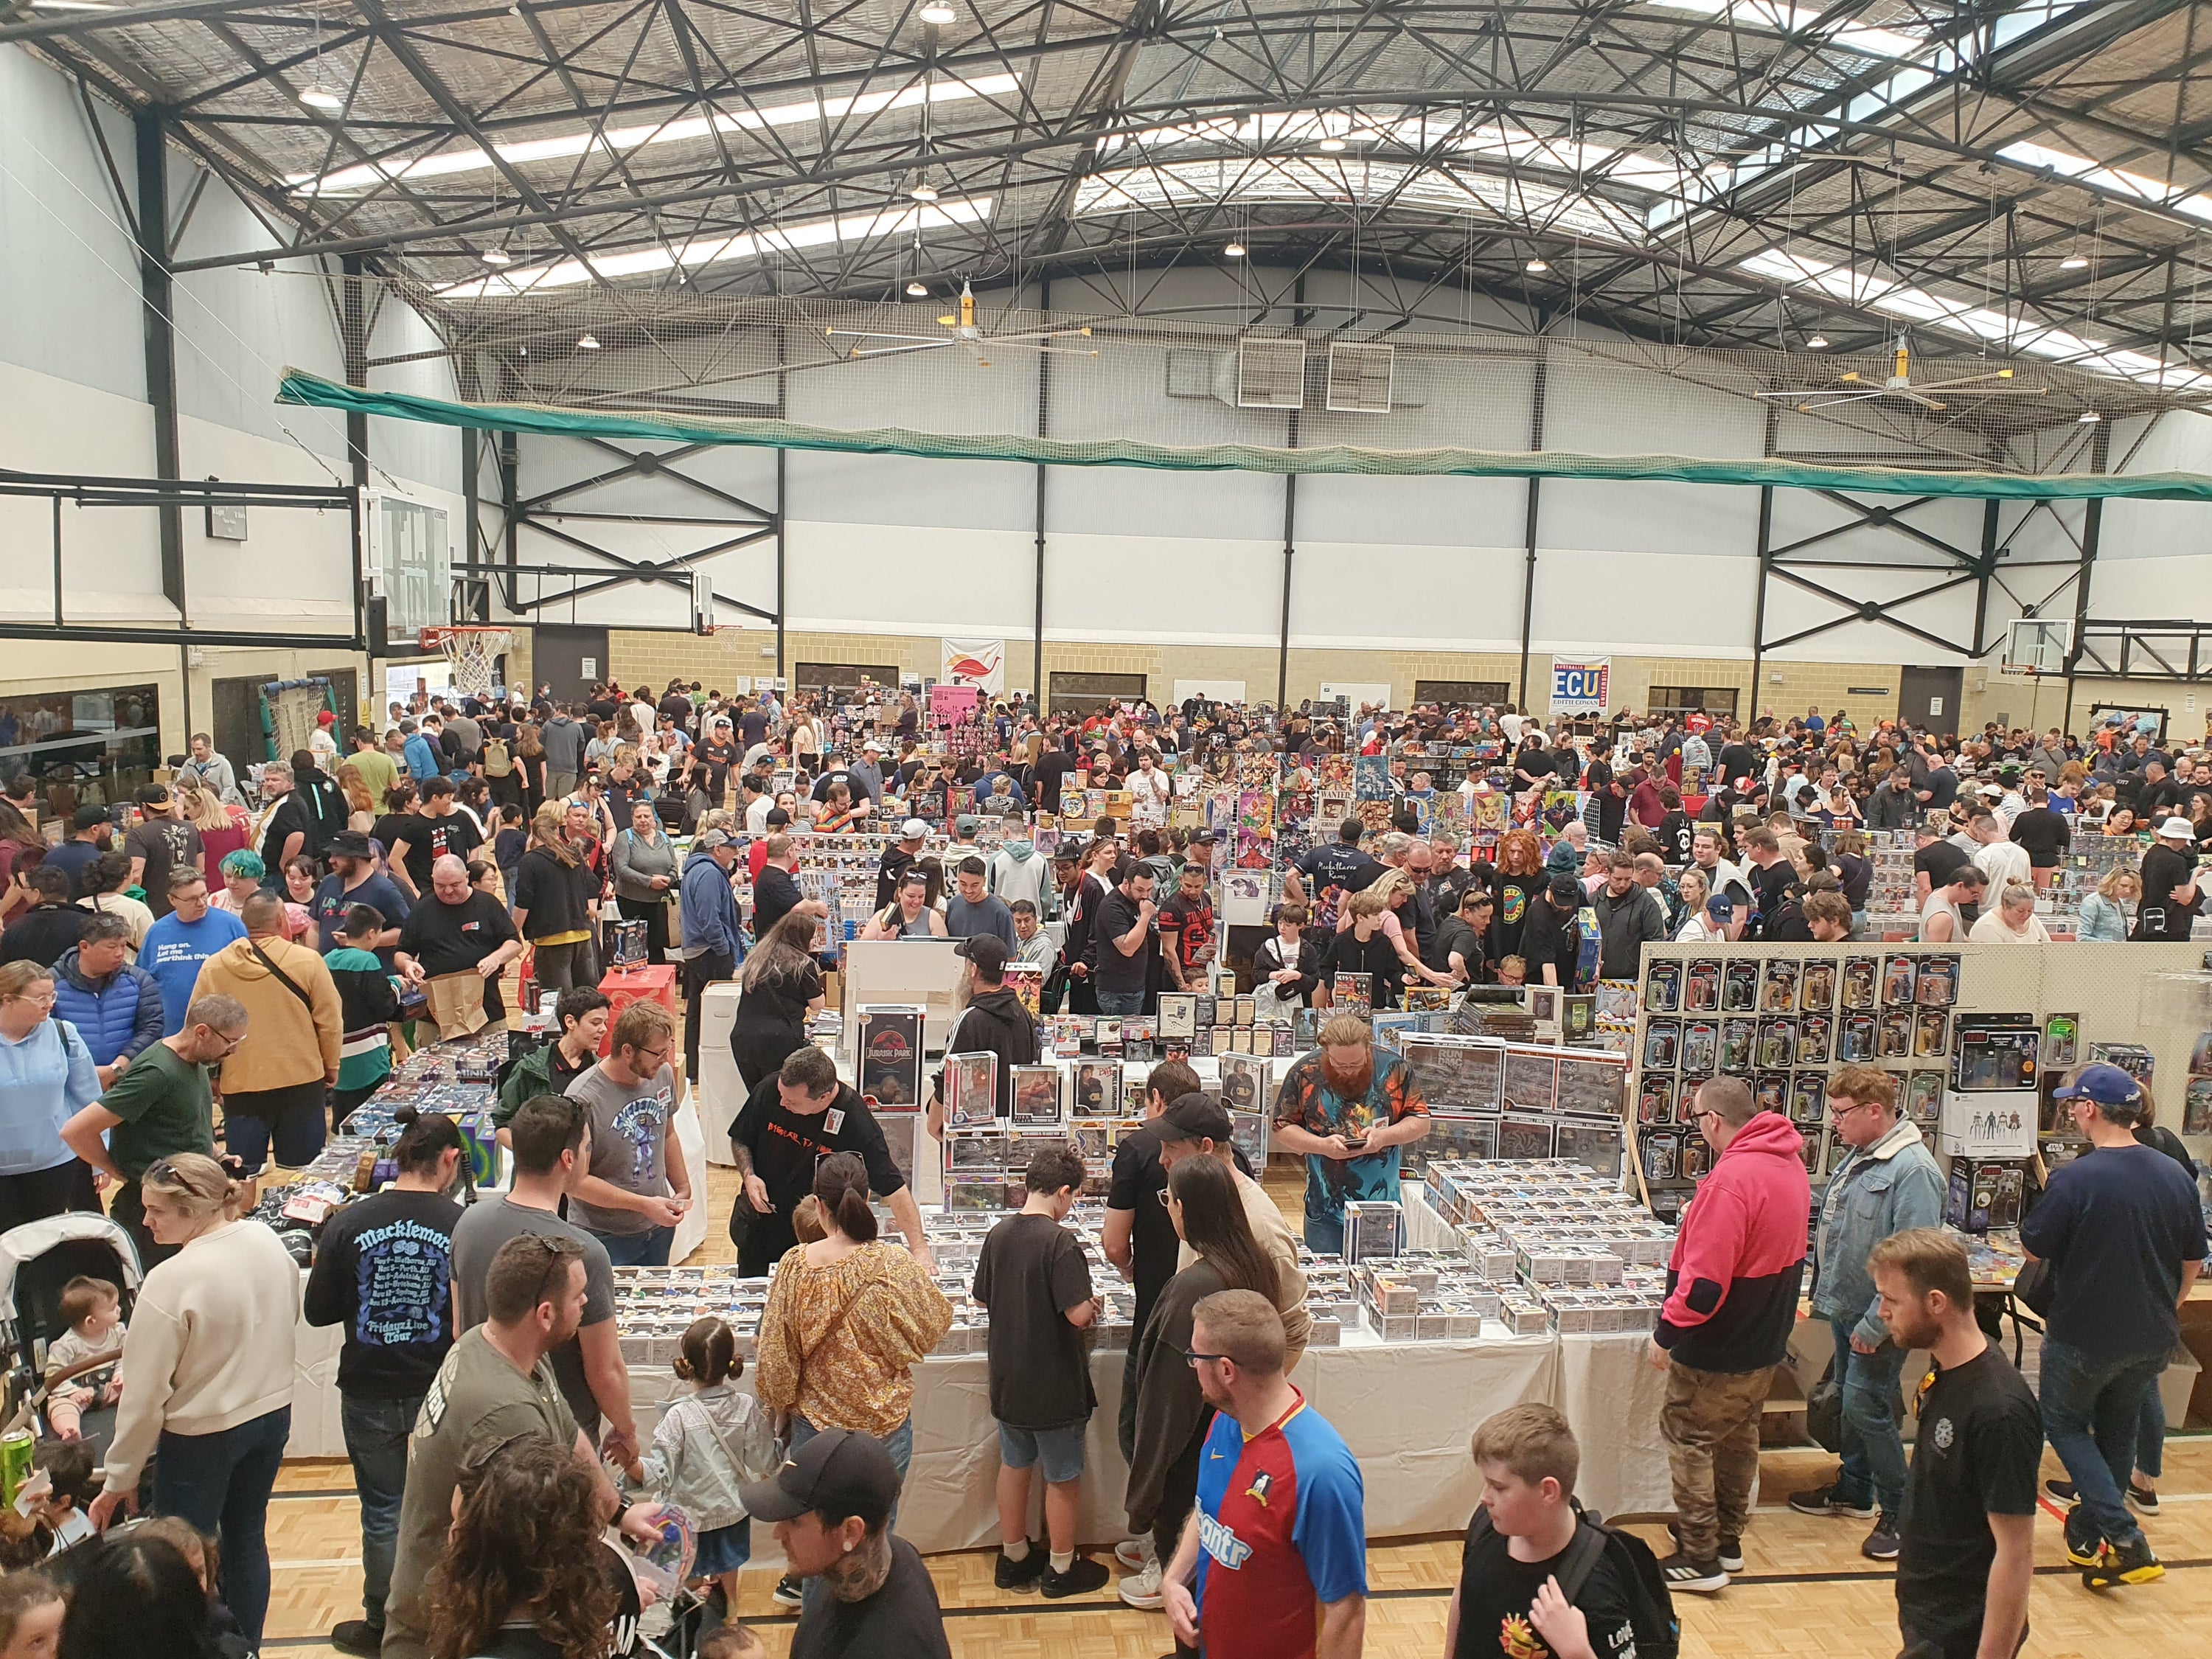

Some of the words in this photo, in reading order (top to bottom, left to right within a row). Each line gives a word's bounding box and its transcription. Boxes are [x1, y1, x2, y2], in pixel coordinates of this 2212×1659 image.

[1552, 671, 1599, 697] ECU
[1321, 790, 1350, 799] WANTED
[1318, 860, 1357, 871] Meekatharra
[1329, 870, 1346, 880] Races
[868, 1049, 893, 1058] JURASSIC
[894, 1048, 911, 1057] PARK
[1438, 1049, 1463, 1058] RUN
[1438, 1057, 1463, 1066] DMC
[354, 1220, 450, 1253] Macklemor
[383, 1332, 411, 1344] Tour
[1608, 1620, 1634, 1649] LOVE
